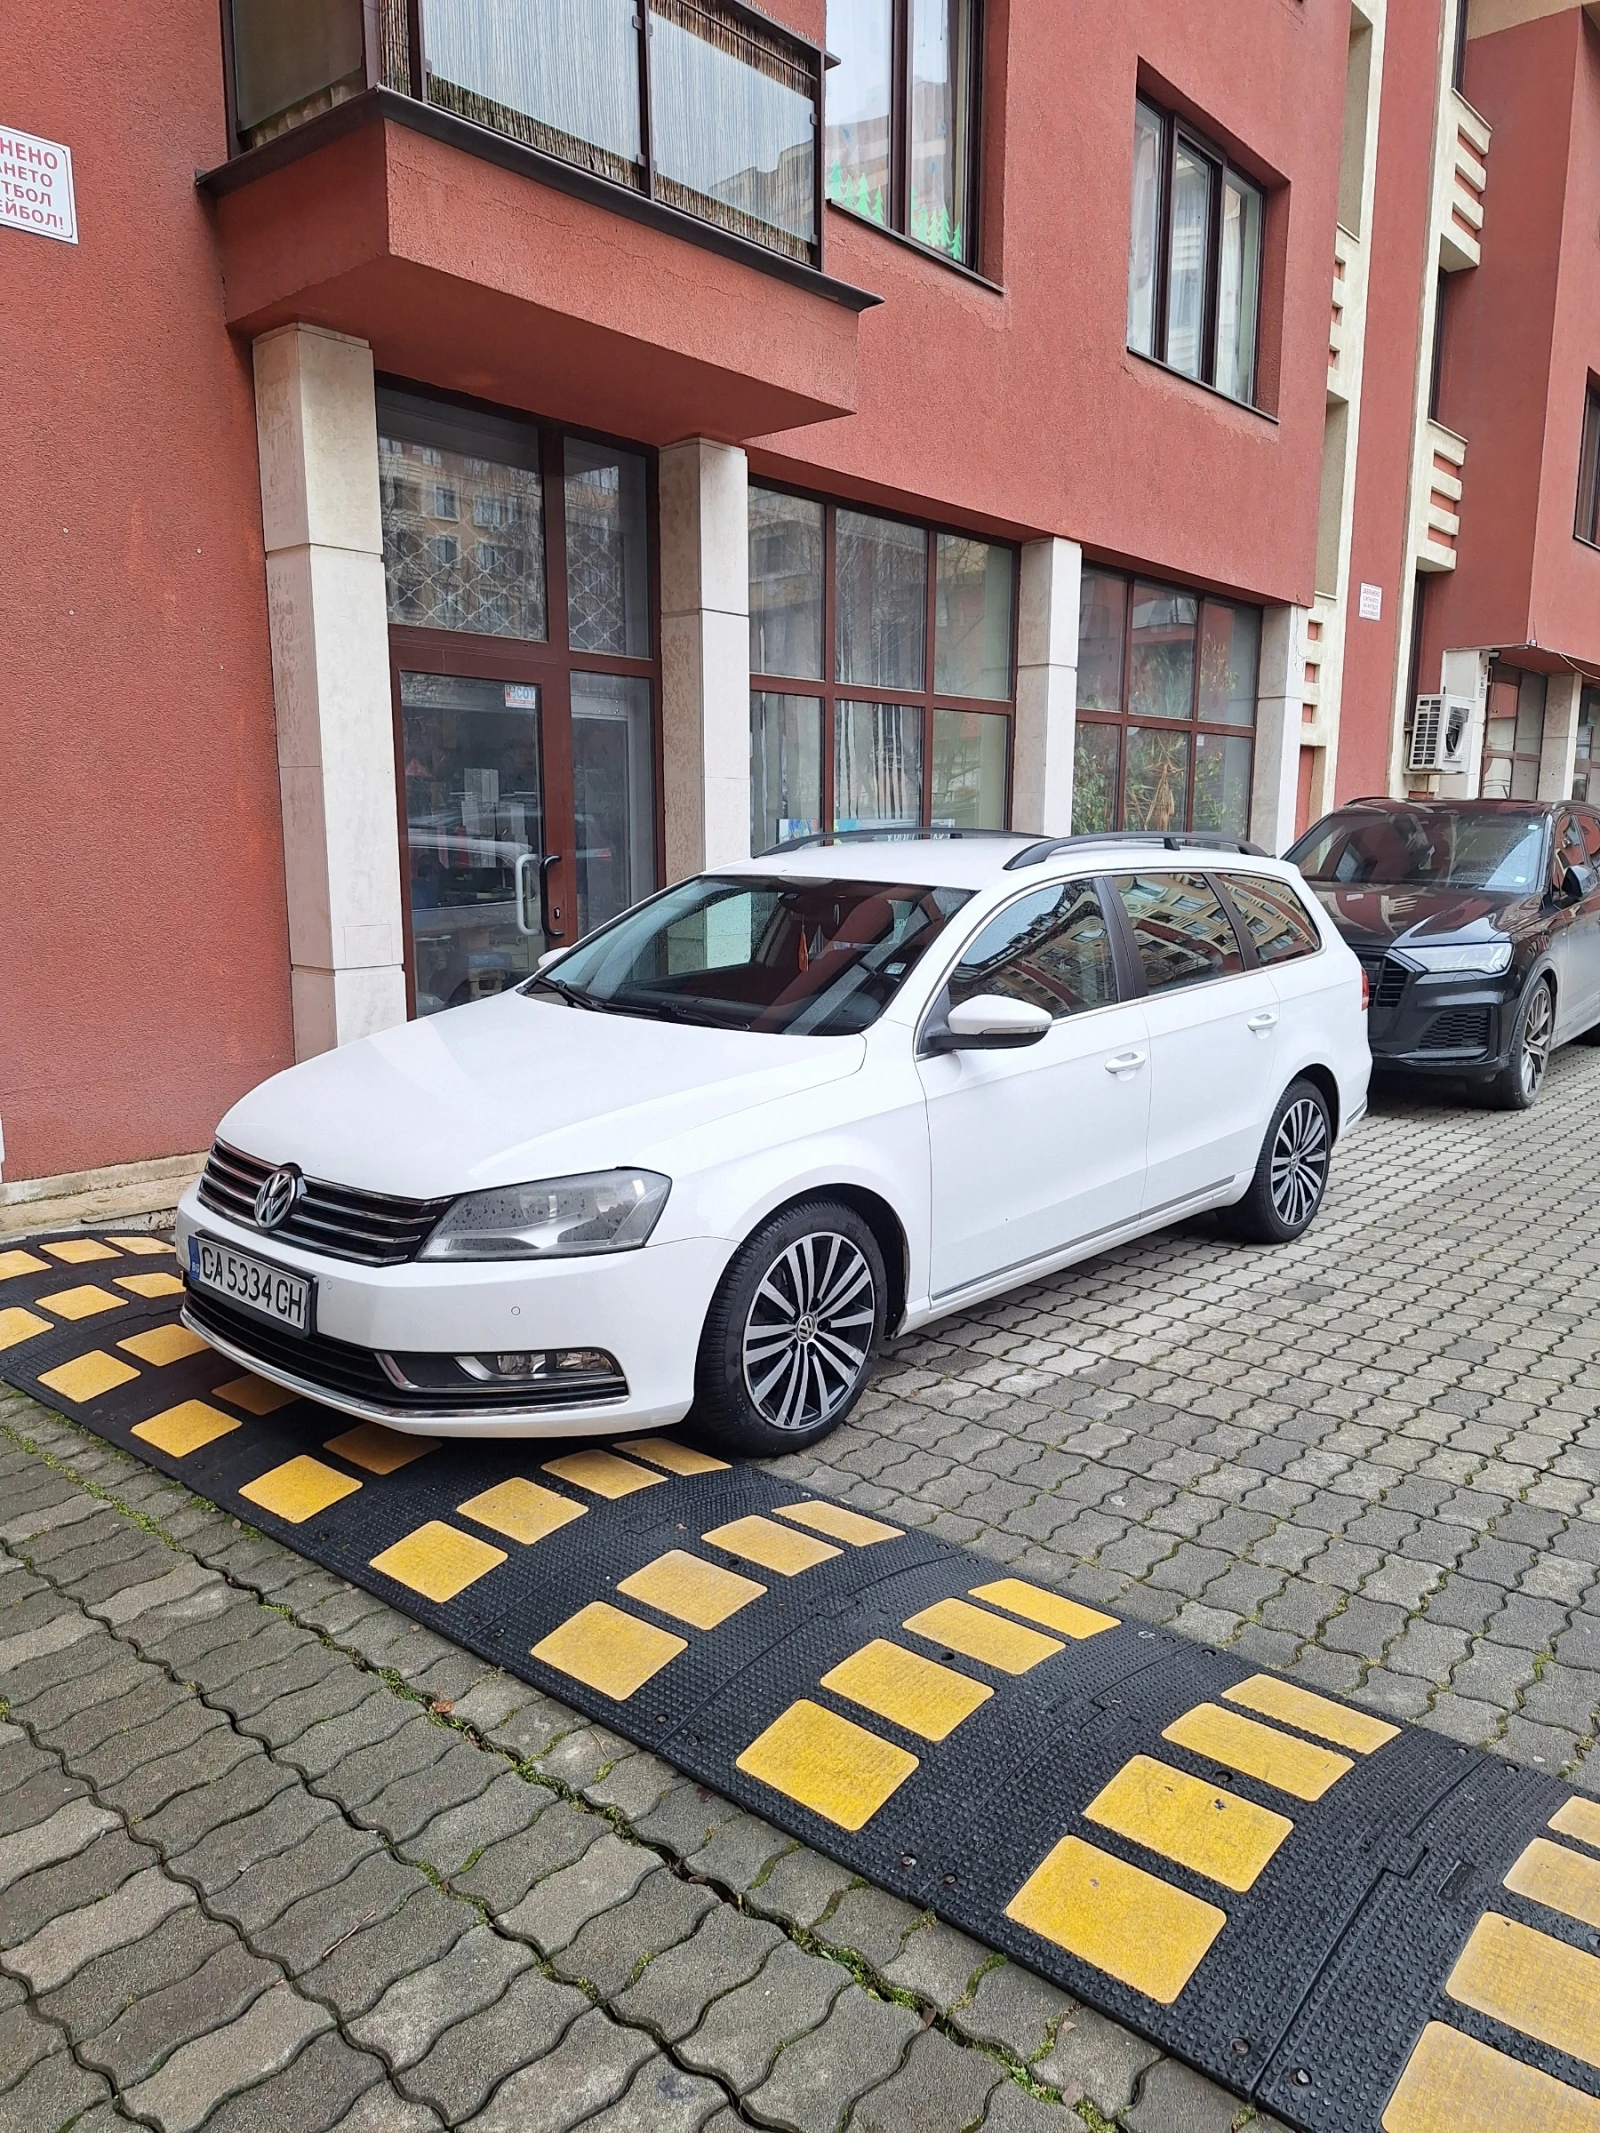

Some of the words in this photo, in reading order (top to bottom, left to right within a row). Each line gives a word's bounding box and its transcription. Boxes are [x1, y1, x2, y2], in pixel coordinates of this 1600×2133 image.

[0, 161, 53, 188] НЕТО
[191, 1261, 200, 1273] BG
[201, 1246, 223, 1286] CA
[227, 1256, 272, 1308] 5334
[276, 1278, 303, 1322] CH
